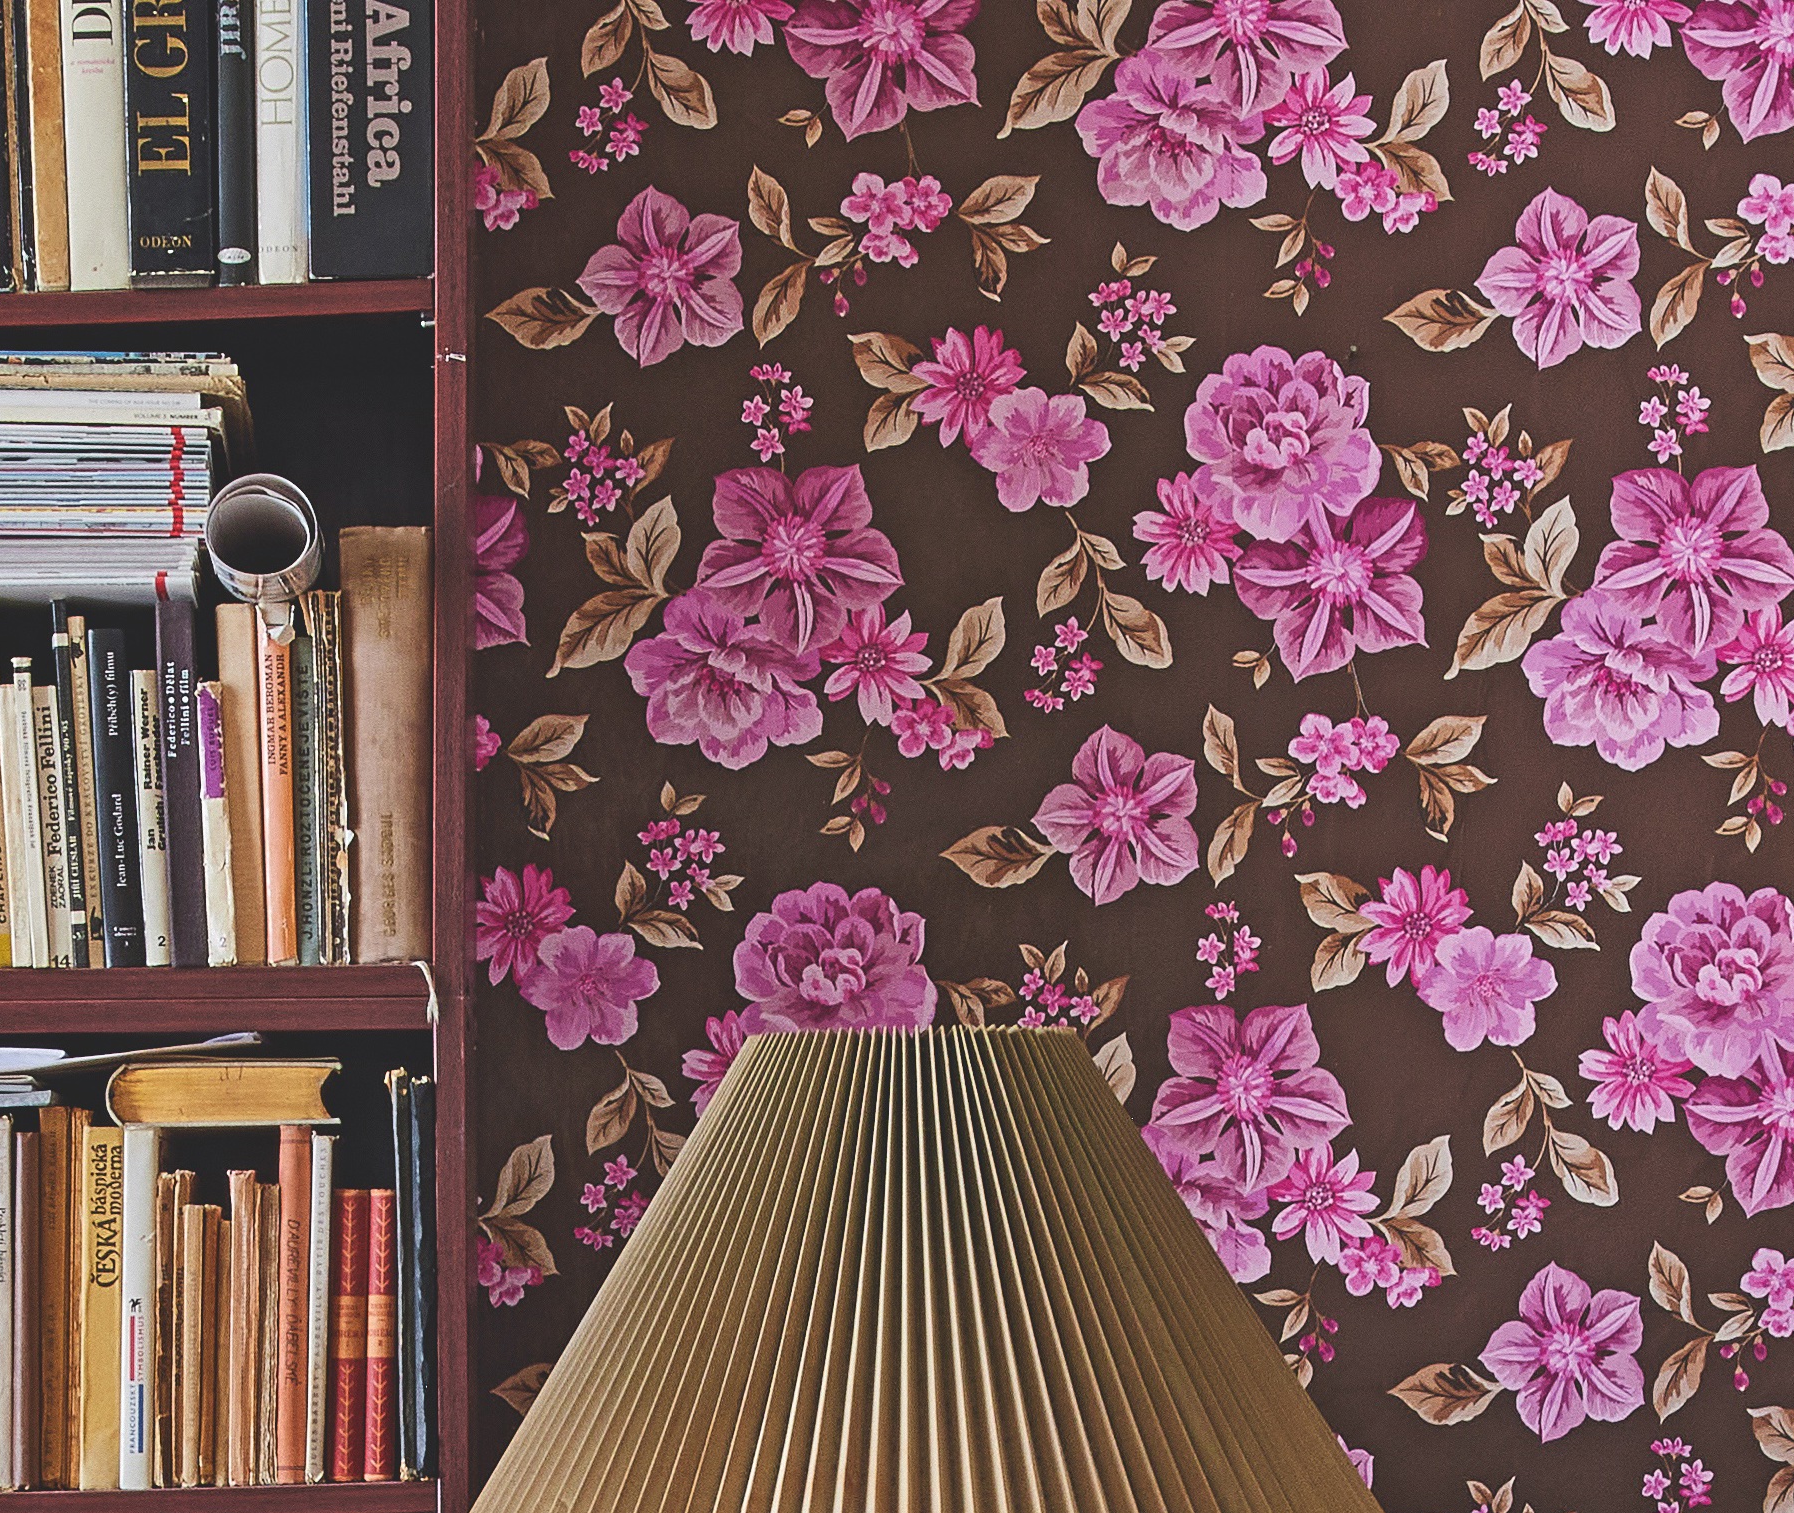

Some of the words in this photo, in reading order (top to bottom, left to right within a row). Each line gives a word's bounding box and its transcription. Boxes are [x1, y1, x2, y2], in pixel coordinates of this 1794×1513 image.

[330, 40, 354, 216] Riefenstahl
[365, 0, 413, 187] Africa
[137, 93, 191, 175] EL
[37, 706, 55, 771] Fellini
[43, 774, 61, 856] Federico
[87, 1144, 108, 1216] básnická
[105, 1146, 122, 1217] moderna
[90, 1220, 120, 1288] ČESKÁ
